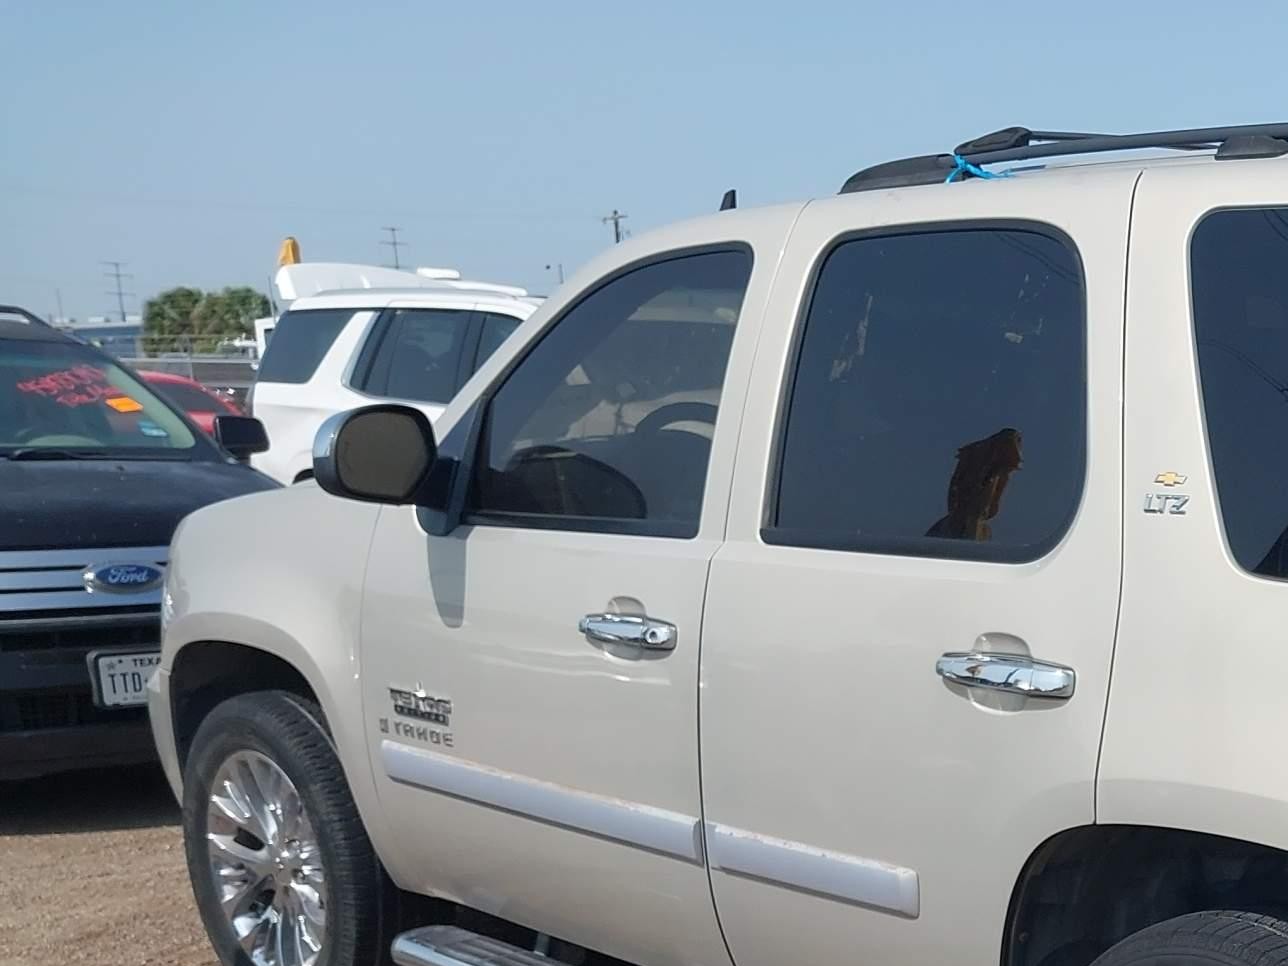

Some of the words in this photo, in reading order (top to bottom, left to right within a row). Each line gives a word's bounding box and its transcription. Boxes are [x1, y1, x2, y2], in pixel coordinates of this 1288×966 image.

[1143, 494, 1190, 515] LTZ
[108, 568, 150, 584] Ford
[393, 721, 454, 747] TAHOE
